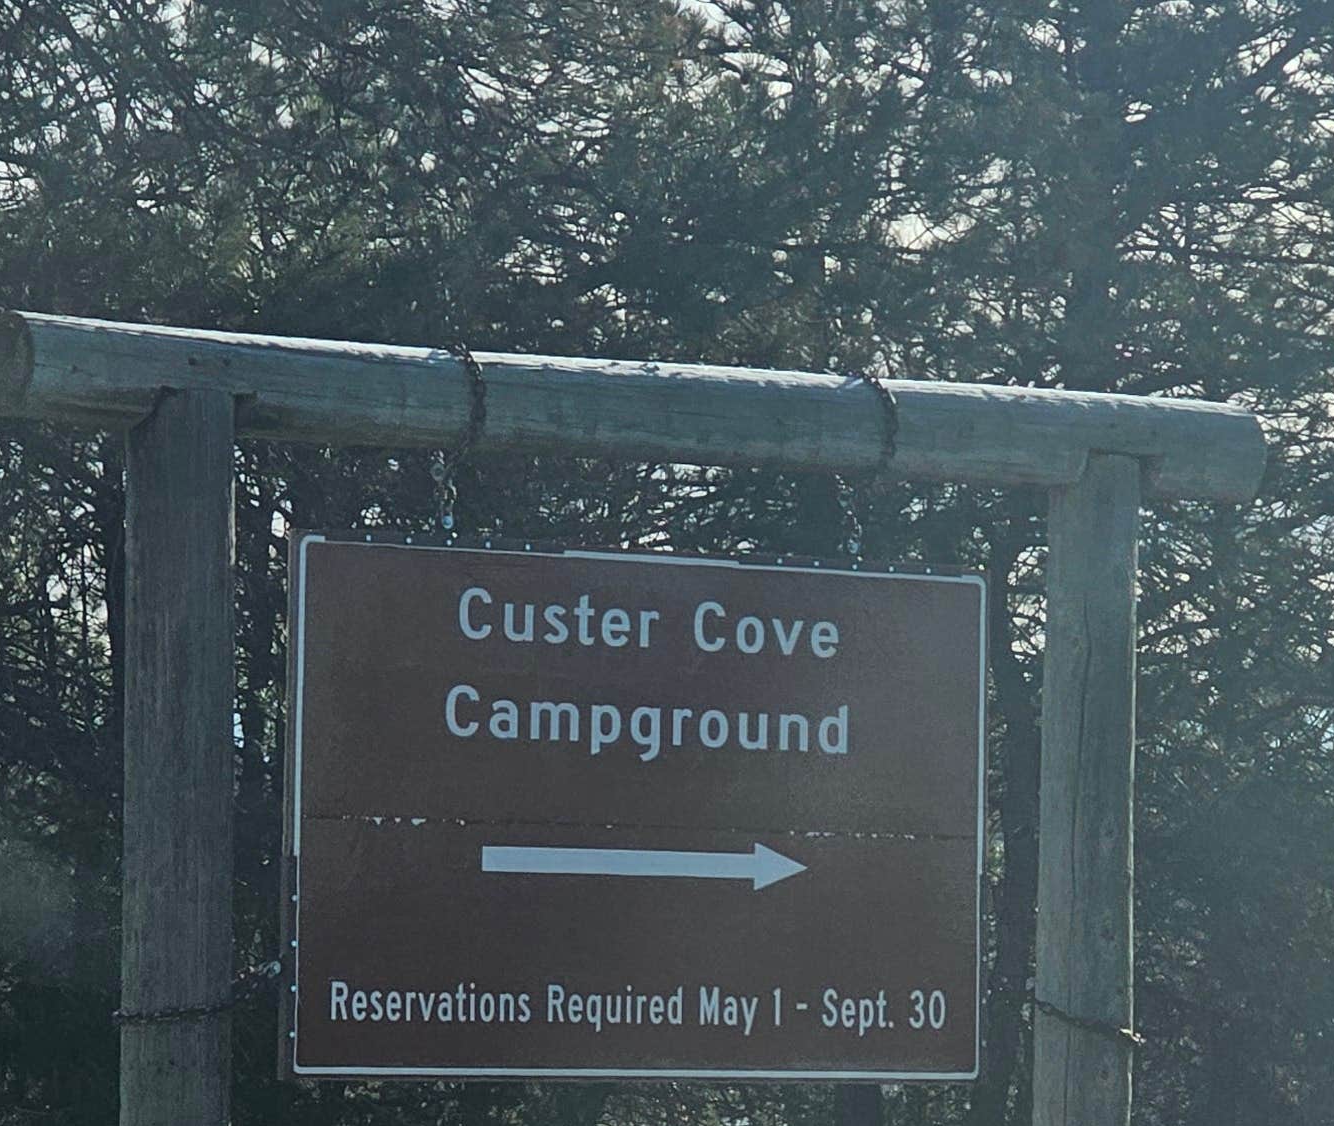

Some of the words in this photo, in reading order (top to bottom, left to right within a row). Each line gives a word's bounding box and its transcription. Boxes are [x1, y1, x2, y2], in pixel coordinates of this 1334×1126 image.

[459, 587, 660, 648] Custer
[693, 601, 840, 659] Cove
[445, 684, 850, 762] Campground
[330, 981, 531, 1023] Reservations
[547, 984, 683, 1033] Required
[699, 985, 759, 1036] May
[773, 987, 783, 1028] 1
[821, 988, 895, 1037] Sept.
[908, 989, 948, 1031] 30
